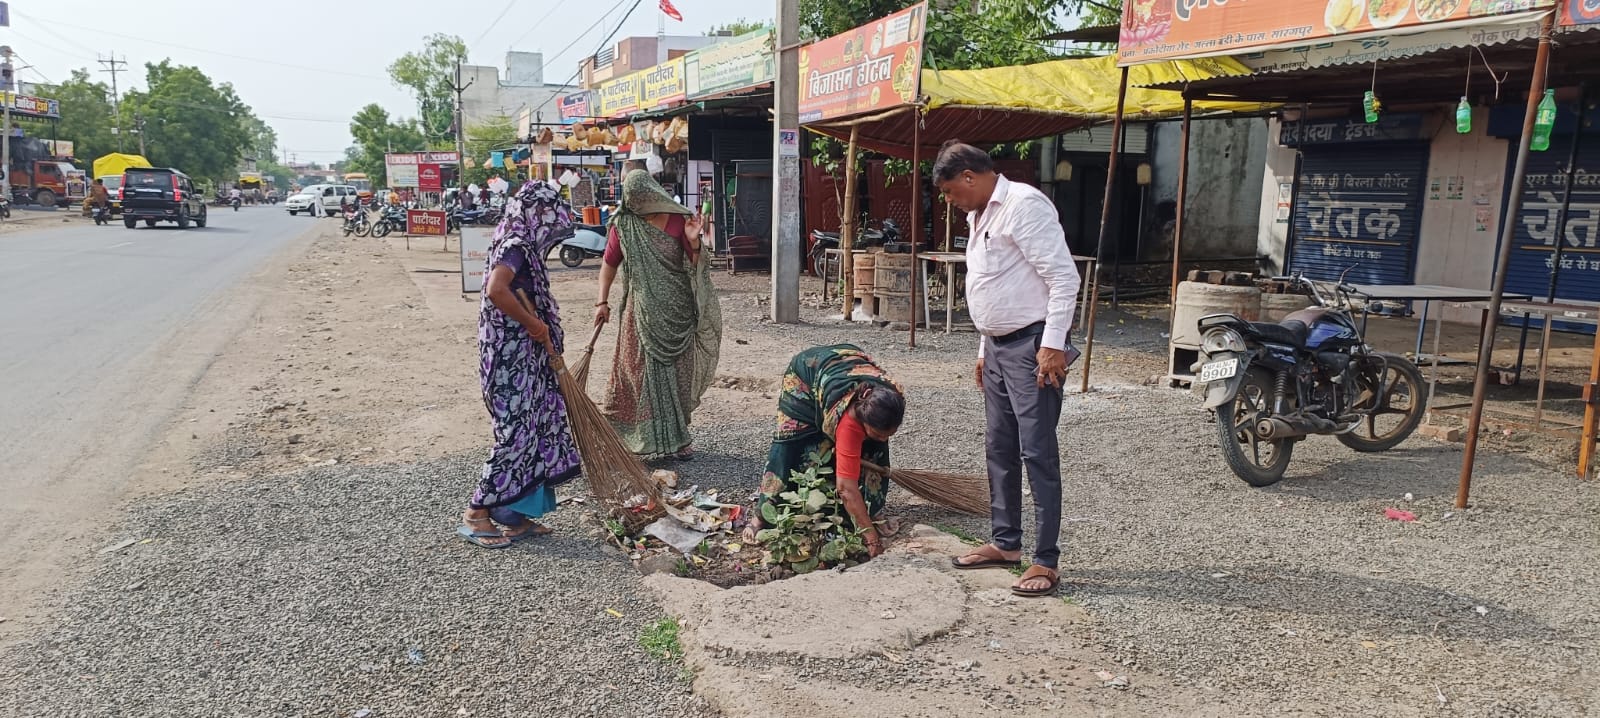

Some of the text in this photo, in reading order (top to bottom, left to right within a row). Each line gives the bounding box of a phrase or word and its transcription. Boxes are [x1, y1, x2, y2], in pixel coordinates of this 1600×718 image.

[1471, 29, 1499, 44] थोक
[1501, 24, 1521, 40] एवं
[647, 65, 674, 84] पाटीदार
[808, 54, 895, 99] बिजासन होटल
[608, 80, 631, 96] पाटीदार
[412, 212, 441, 225] पाटीदार
[1306, 191, 1407, 240] चेतक
[1545, 252, 1573, 269] समेंट
[1576, 255, 1588, 269] से
[1203, 366, 1233, 381] 9901
